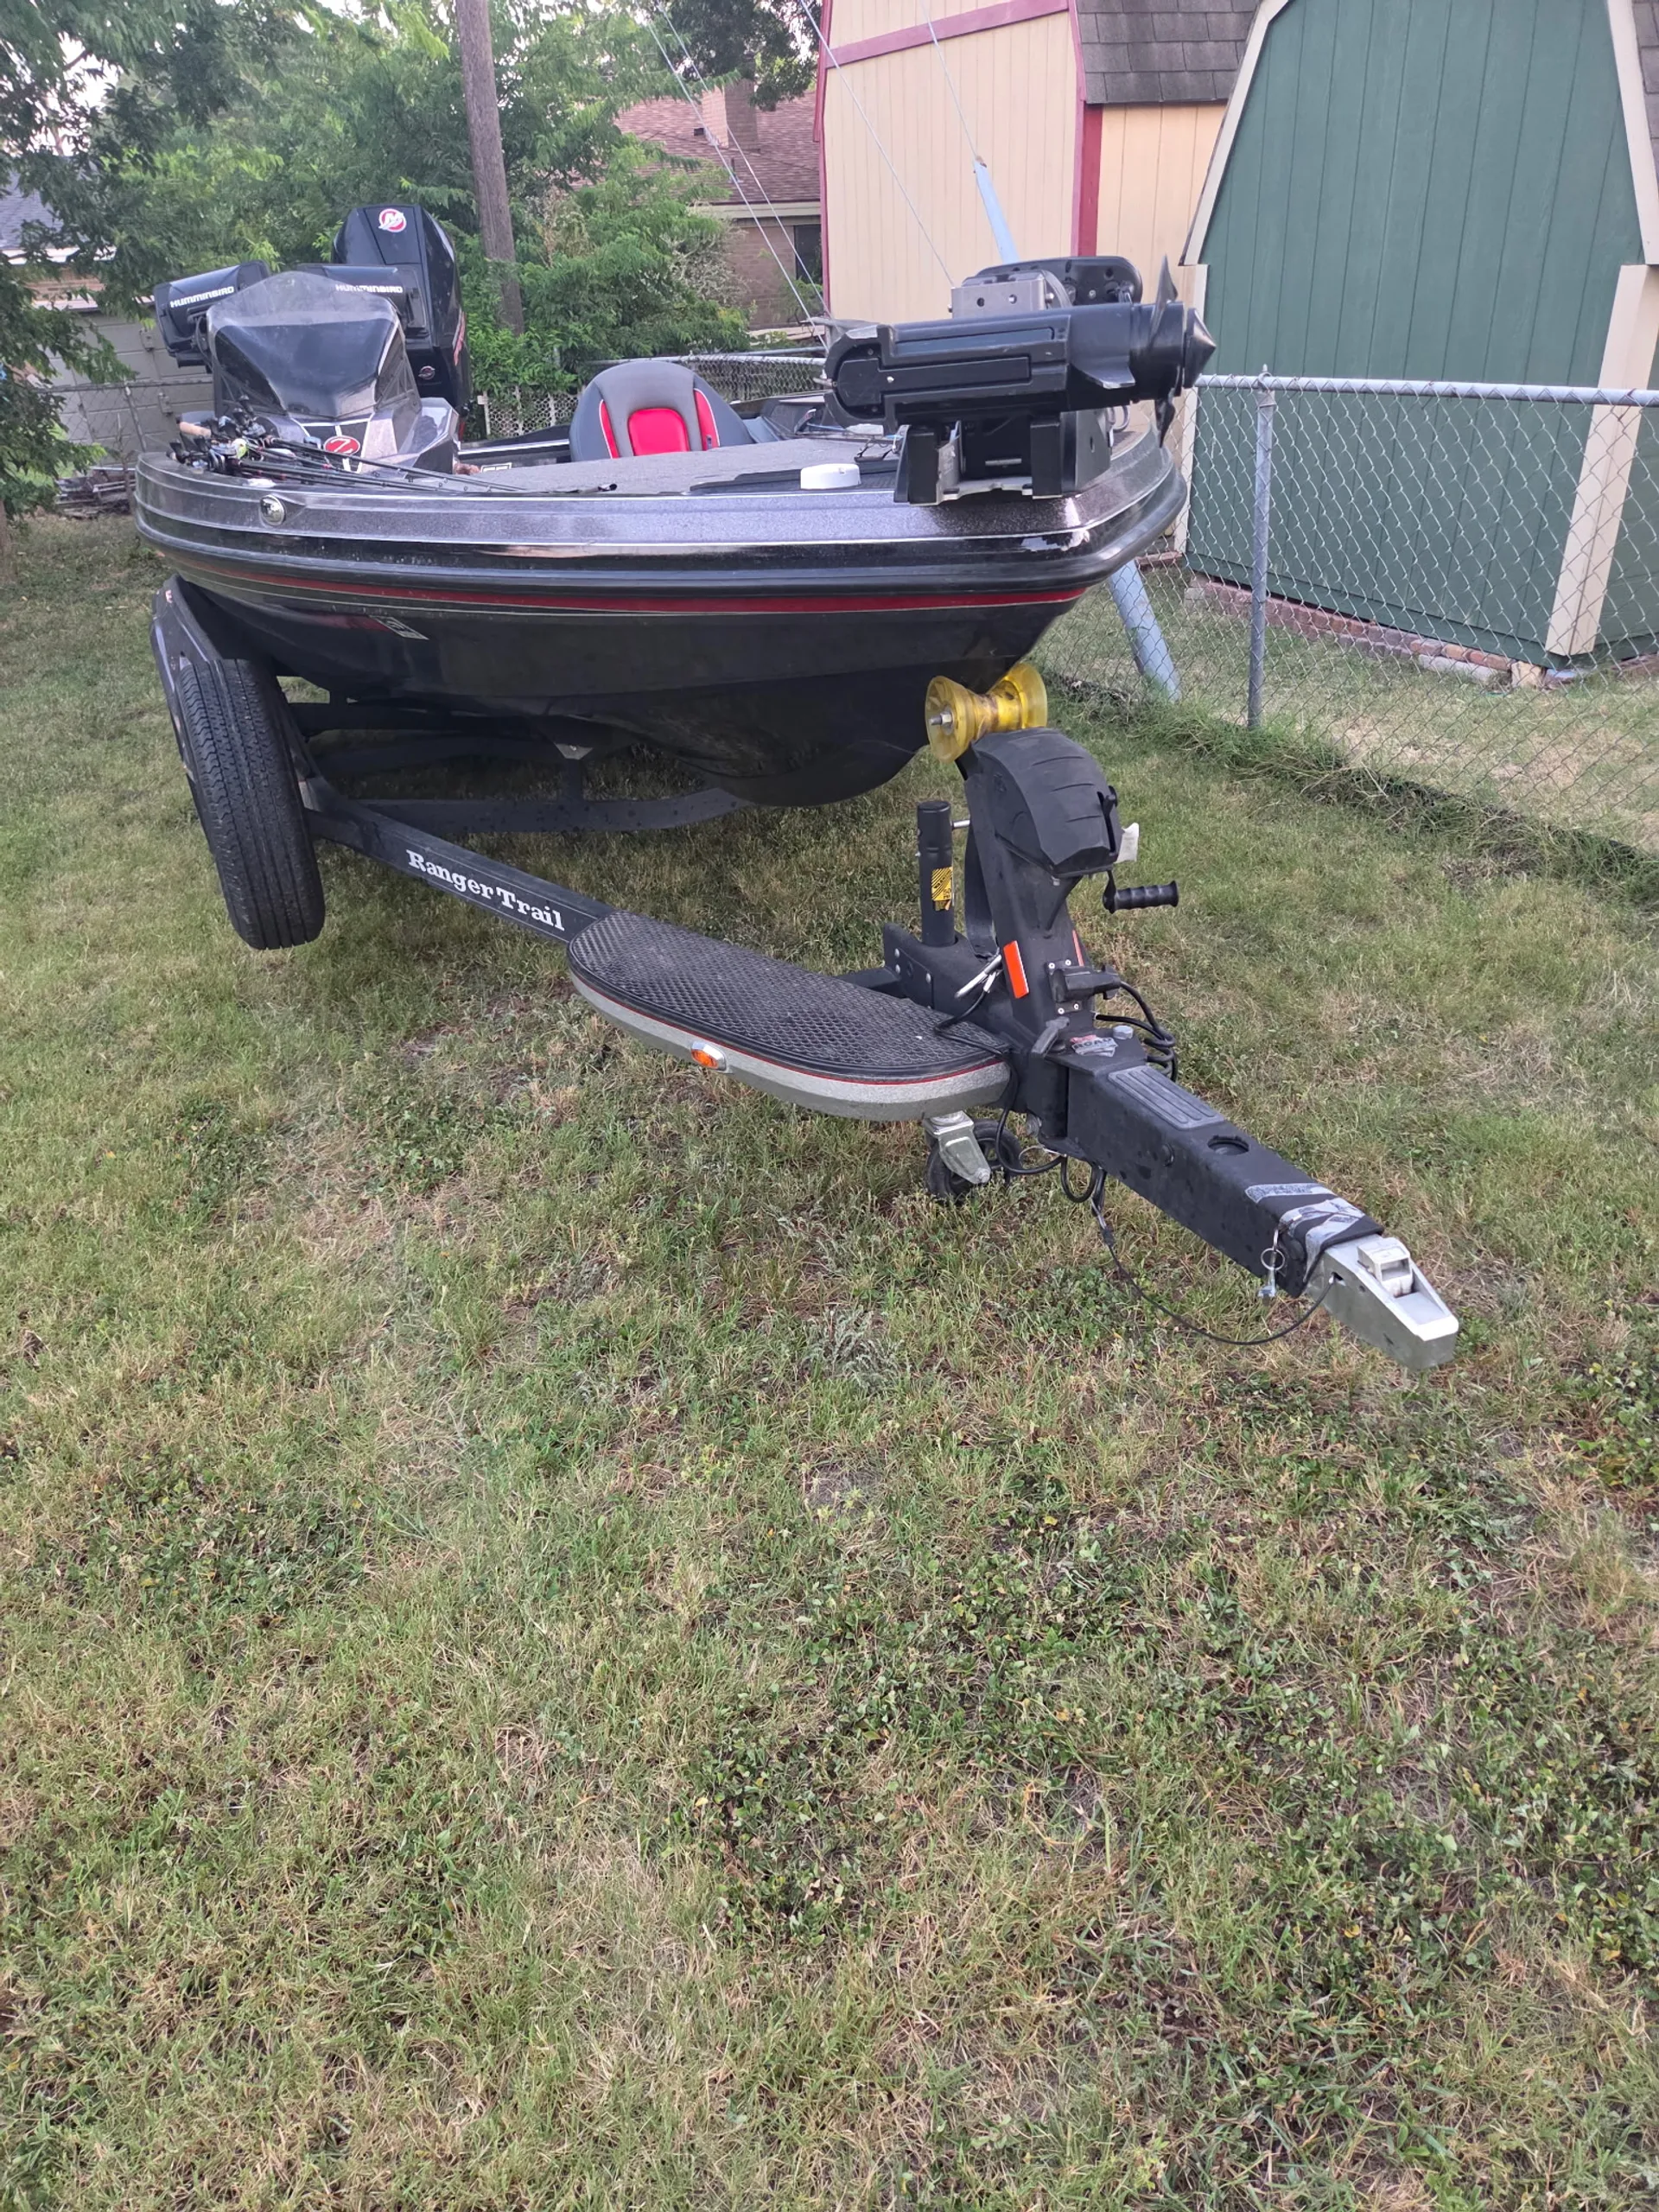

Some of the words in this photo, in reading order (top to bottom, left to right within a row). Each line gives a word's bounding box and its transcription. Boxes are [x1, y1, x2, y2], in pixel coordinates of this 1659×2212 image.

[169, 286, 235, 308] HUMMINBIRD
[334, 284, 404, 293] HUMMINBIRD
[405, 849, 494, 899] Ranger
[496, 887, 565, 931] Trail
